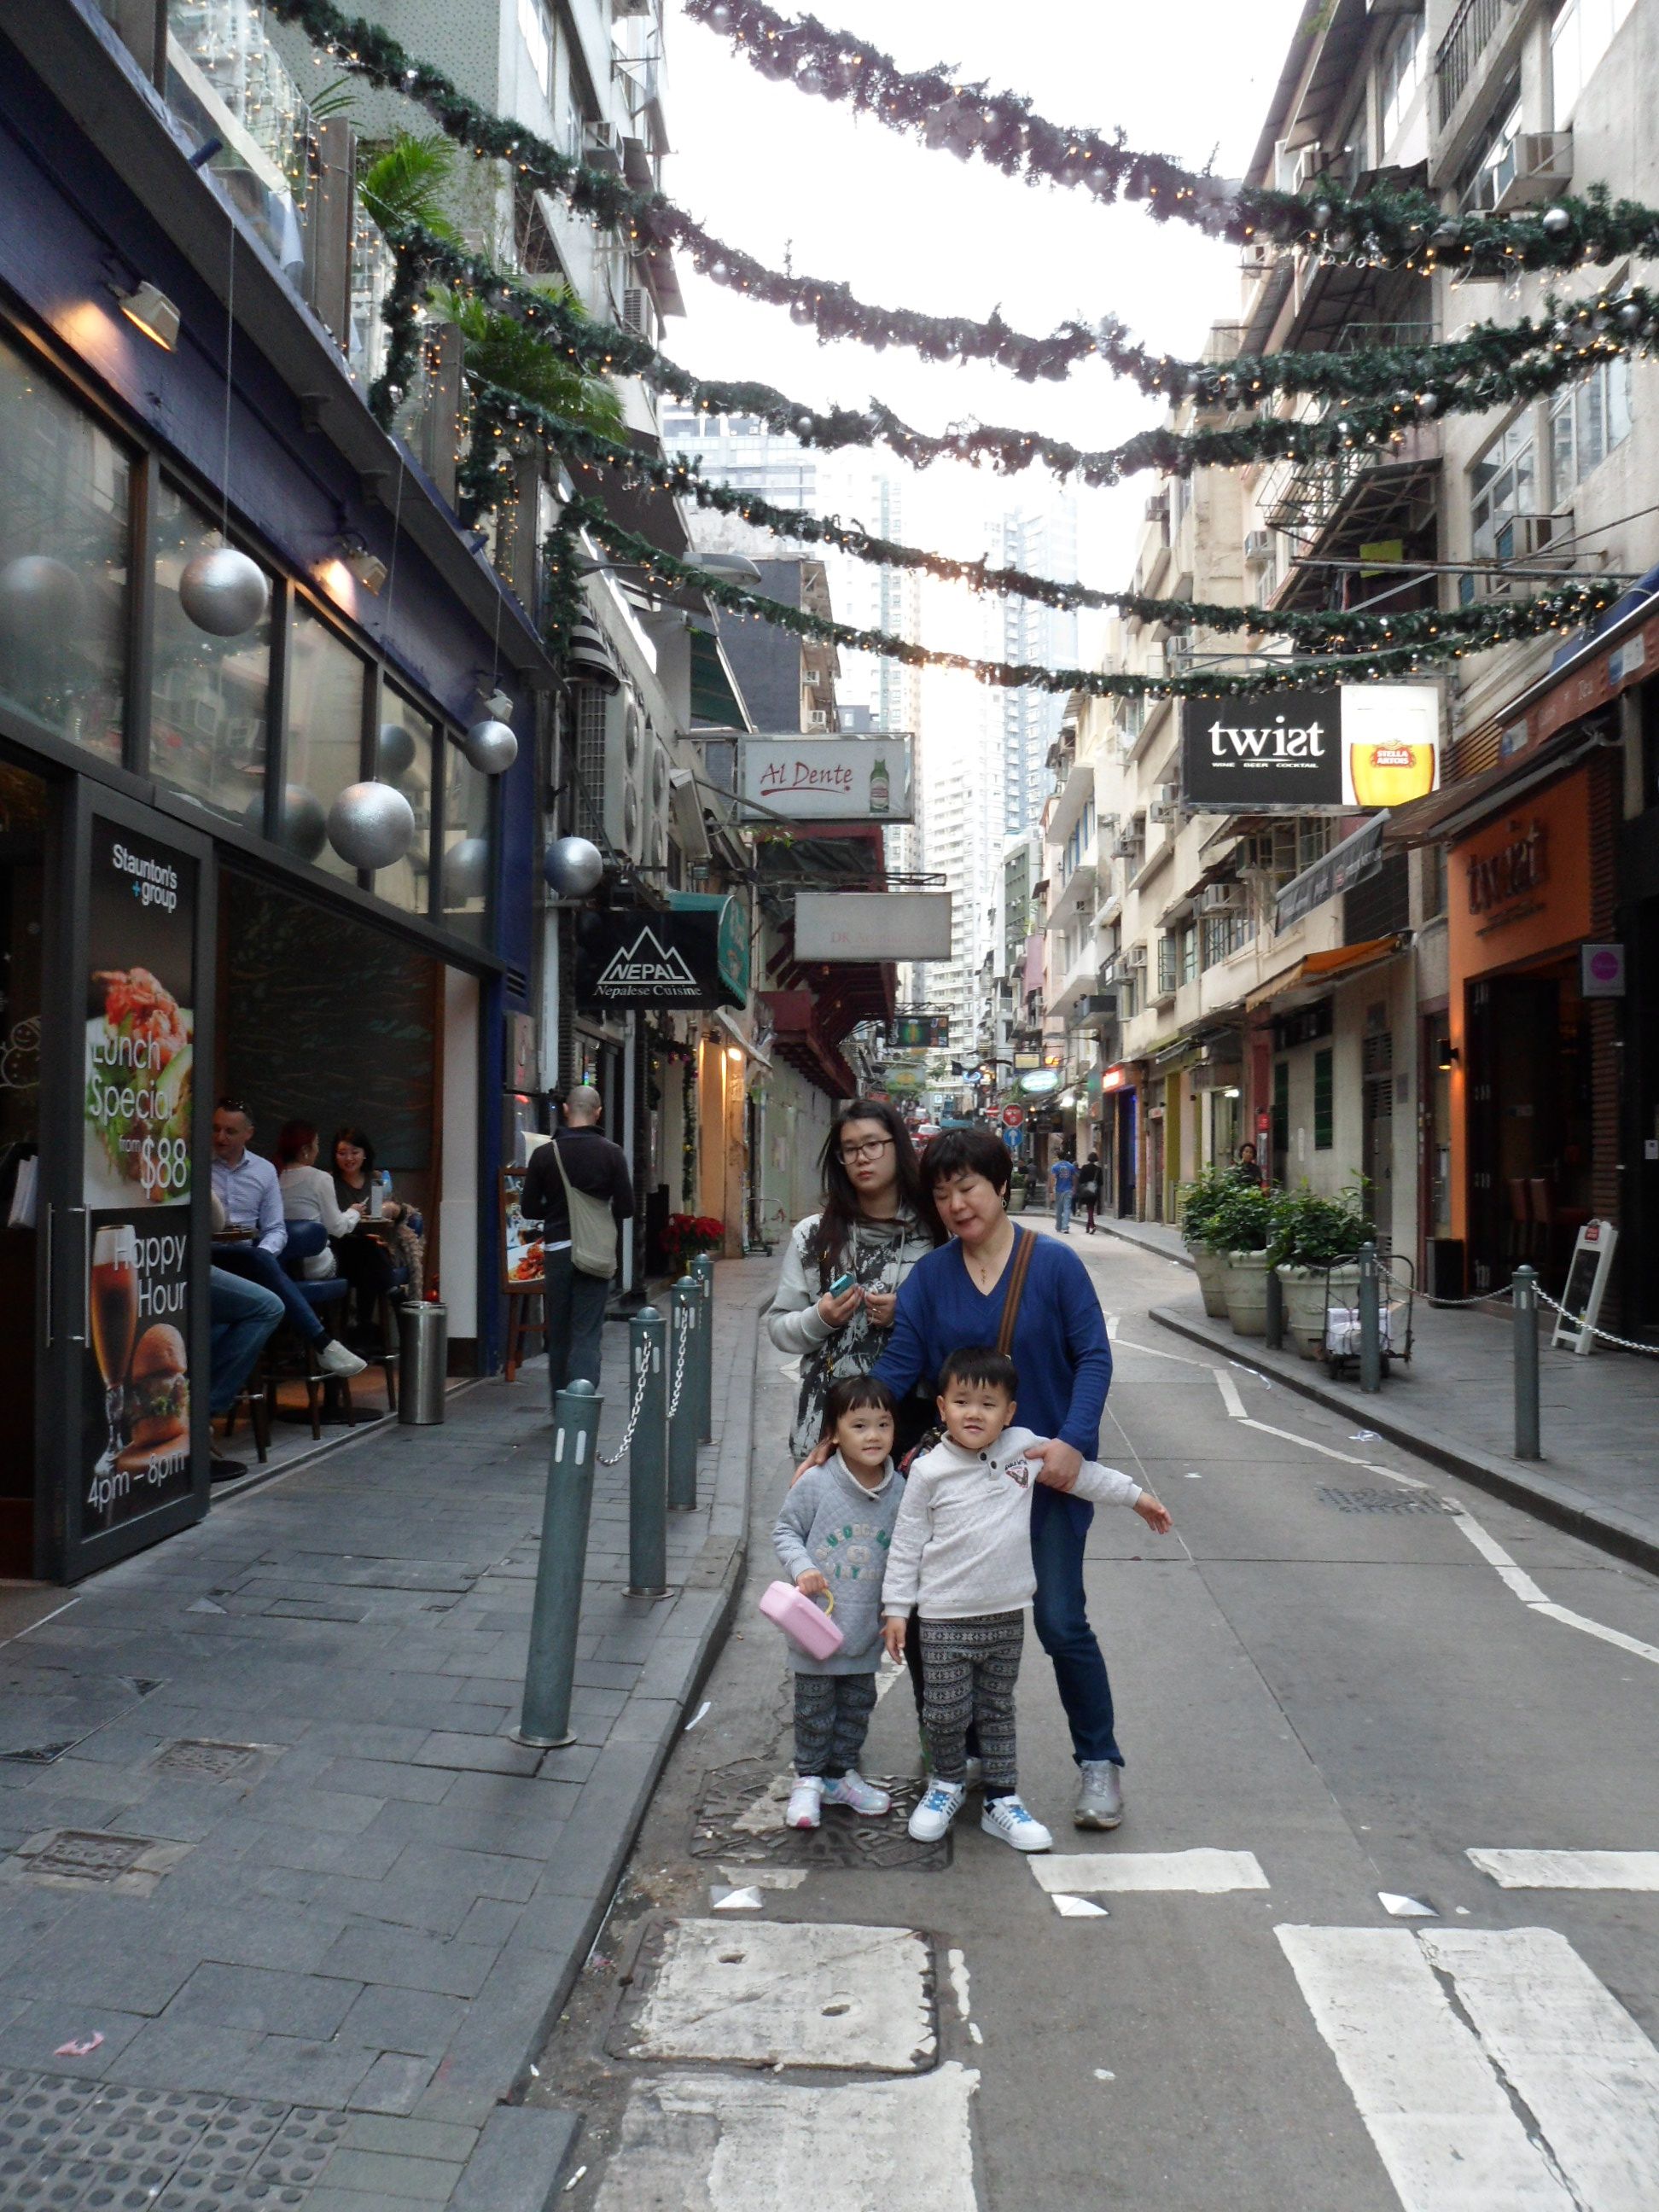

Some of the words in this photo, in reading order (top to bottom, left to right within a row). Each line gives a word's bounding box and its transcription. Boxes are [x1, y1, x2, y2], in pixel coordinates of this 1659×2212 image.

[1208, 715, 1325, 757] twist
[760, 763, 787, 784] Al
[792, 761, 853, 786] Dente
[113, 844, 178, 889] Staunton's
[592, 985, 649, 998] Nepalese
[653, 985, 702, 996] Cuisine
[608, 963, 685, 980] NEPAL
[91, 1031, 161, 1070] Lunch
[89, 1074, 173, 1126] Specia
[141, 1135, 187, 1200] $88
[114, 1235, 187, 1277] Happy
[138, 1278, 187, 1318] Hour
[87, 1471, 130, 1513] 4pm
[148, 1453, 184, 1487] 8pm
